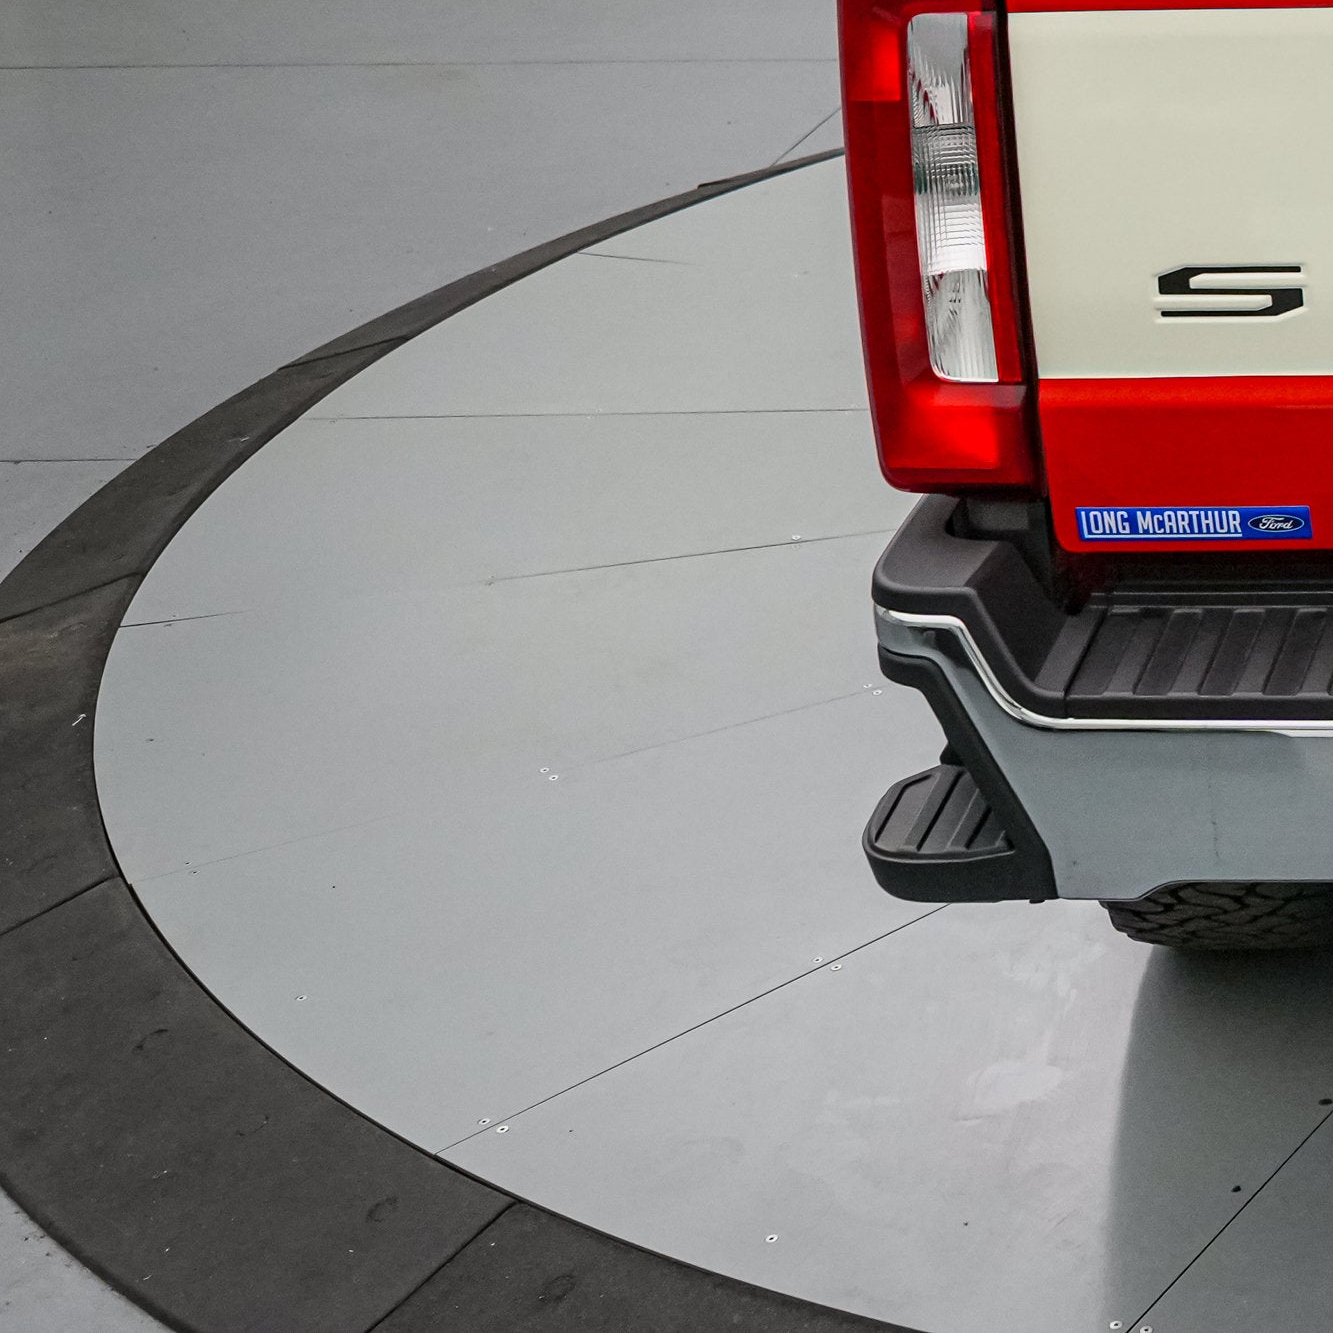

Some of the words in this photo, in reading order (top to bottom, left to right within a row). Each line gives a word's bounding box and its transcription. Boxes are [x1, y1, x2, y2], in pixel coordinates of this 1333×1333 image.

[1081, 510, 1131, 537] LONG
[1137, 509, 1242, 534] McARTHUR
[1258, 516, 1294, 530] Ford
